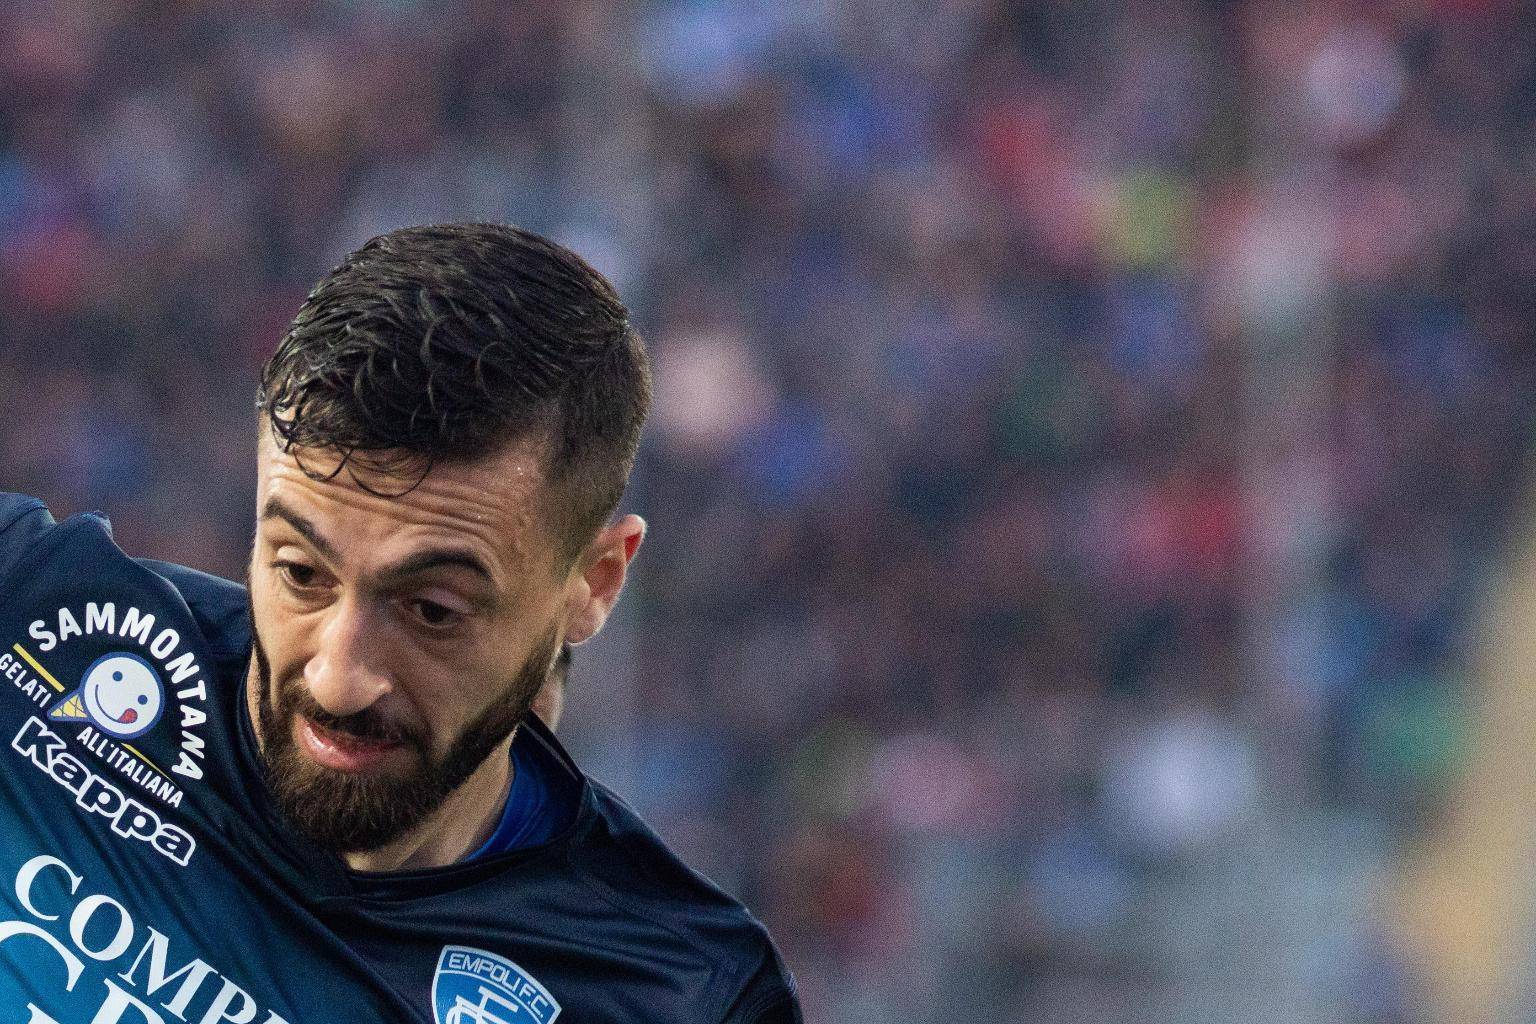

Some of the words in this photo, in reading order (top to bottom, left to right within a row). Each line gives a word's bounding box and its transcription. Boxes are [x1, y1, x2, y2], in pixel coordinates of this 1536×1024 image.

[28, 601, 207, 781] SAMMONTANA
[76, 726, 184, 808] ALL'ITALIANA
[448, 952, 521, 991] EMPOLI
